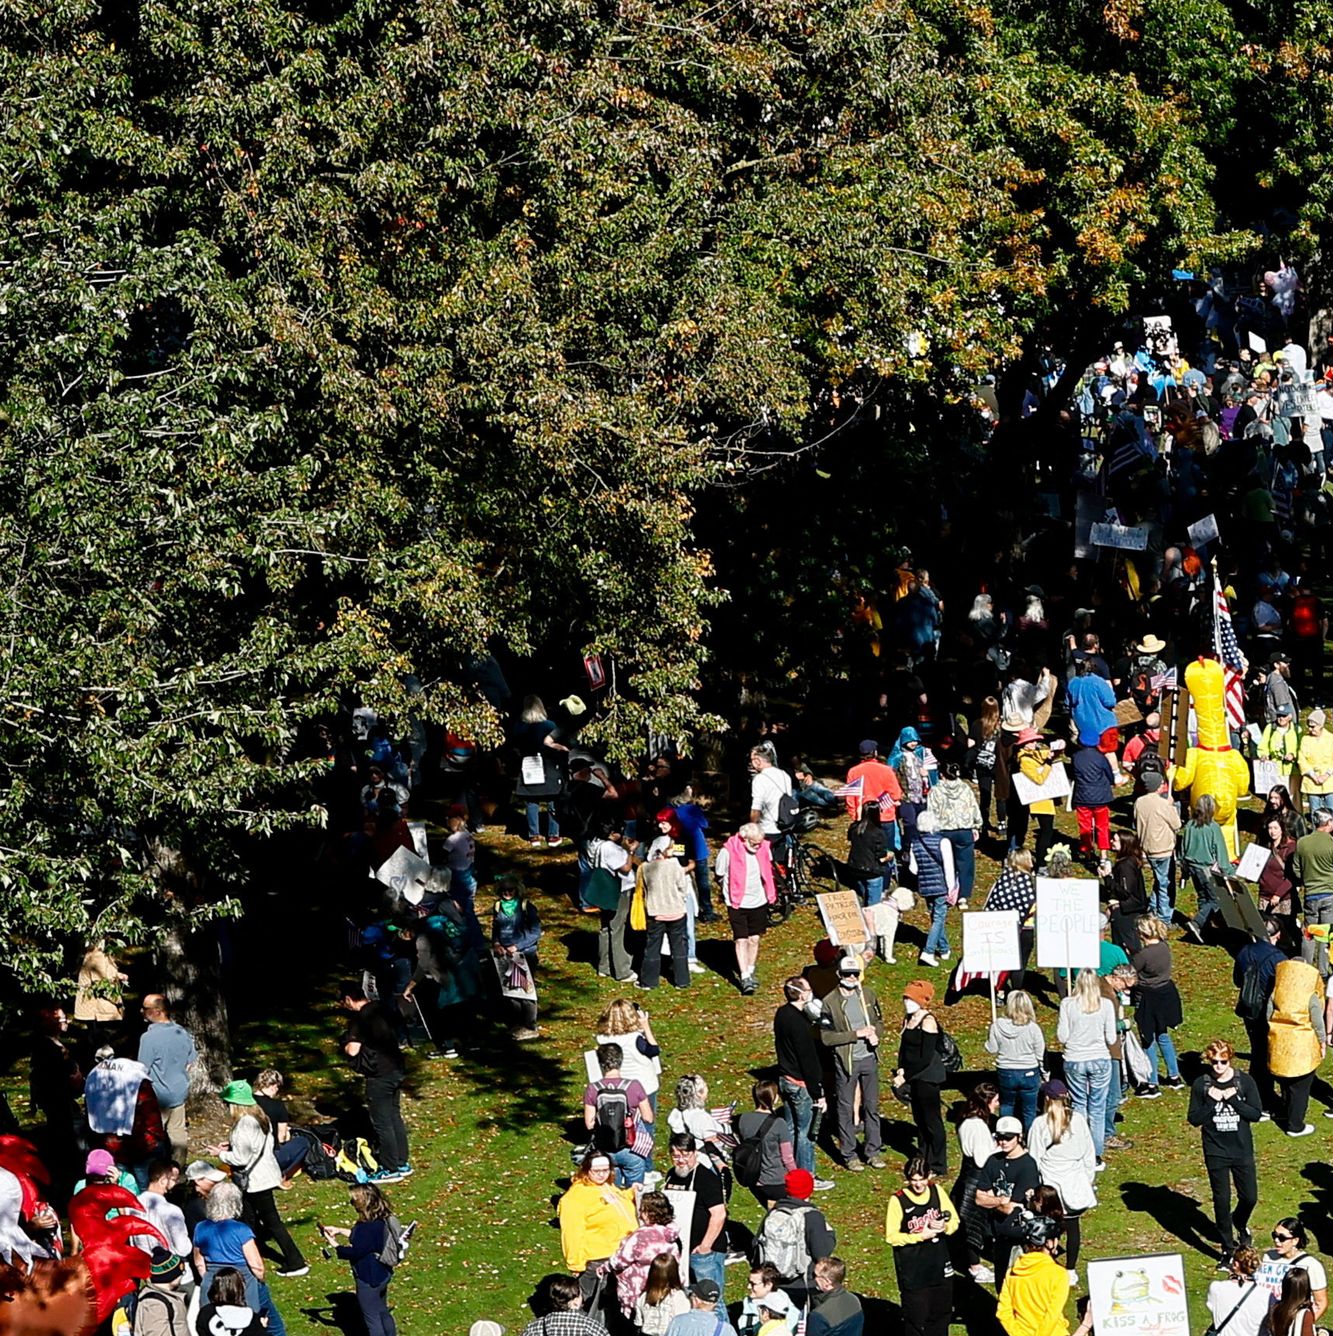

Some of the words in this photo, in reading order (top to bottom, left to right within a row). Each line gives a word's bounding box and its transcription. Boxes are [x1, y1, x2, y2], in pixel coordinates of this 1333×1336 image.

[1061, 883, 1080, 896] WE
[1054, 898, 1082, 912] THE
[983, 930, 1008, 944] IS
[1103, 1315, 1136, 1331] KISS
[1157, 1311, 1187, 1325] FROG
